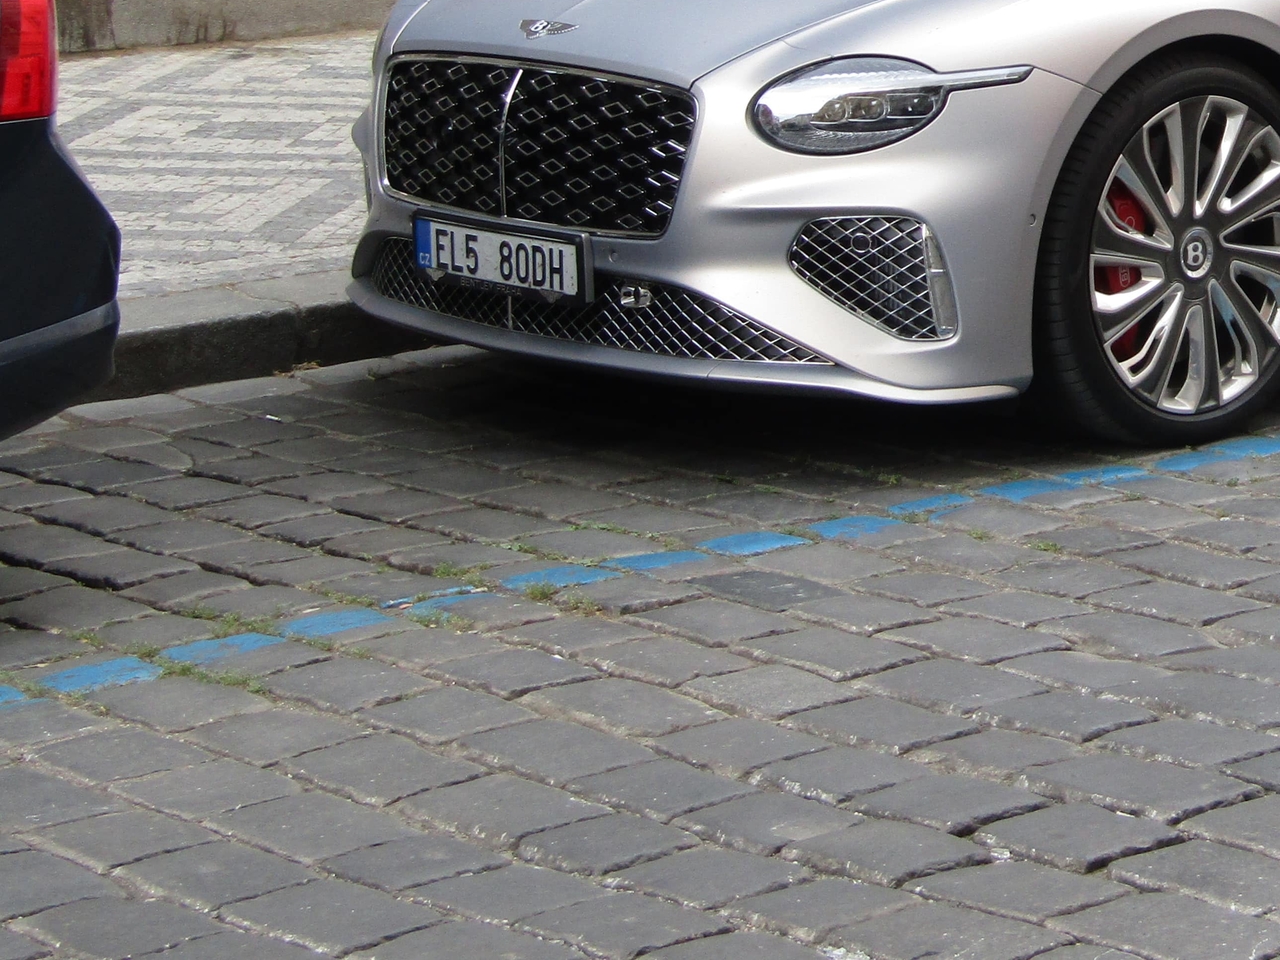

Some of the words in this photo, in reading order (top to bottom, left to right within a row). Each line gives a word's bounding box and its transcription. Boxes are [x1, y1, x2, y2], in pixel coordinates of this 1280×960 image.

[419, 252, 430, 266] CZ
[435, 228, 479, 275] EL5
[499, 240, 564, 291] 80DH
